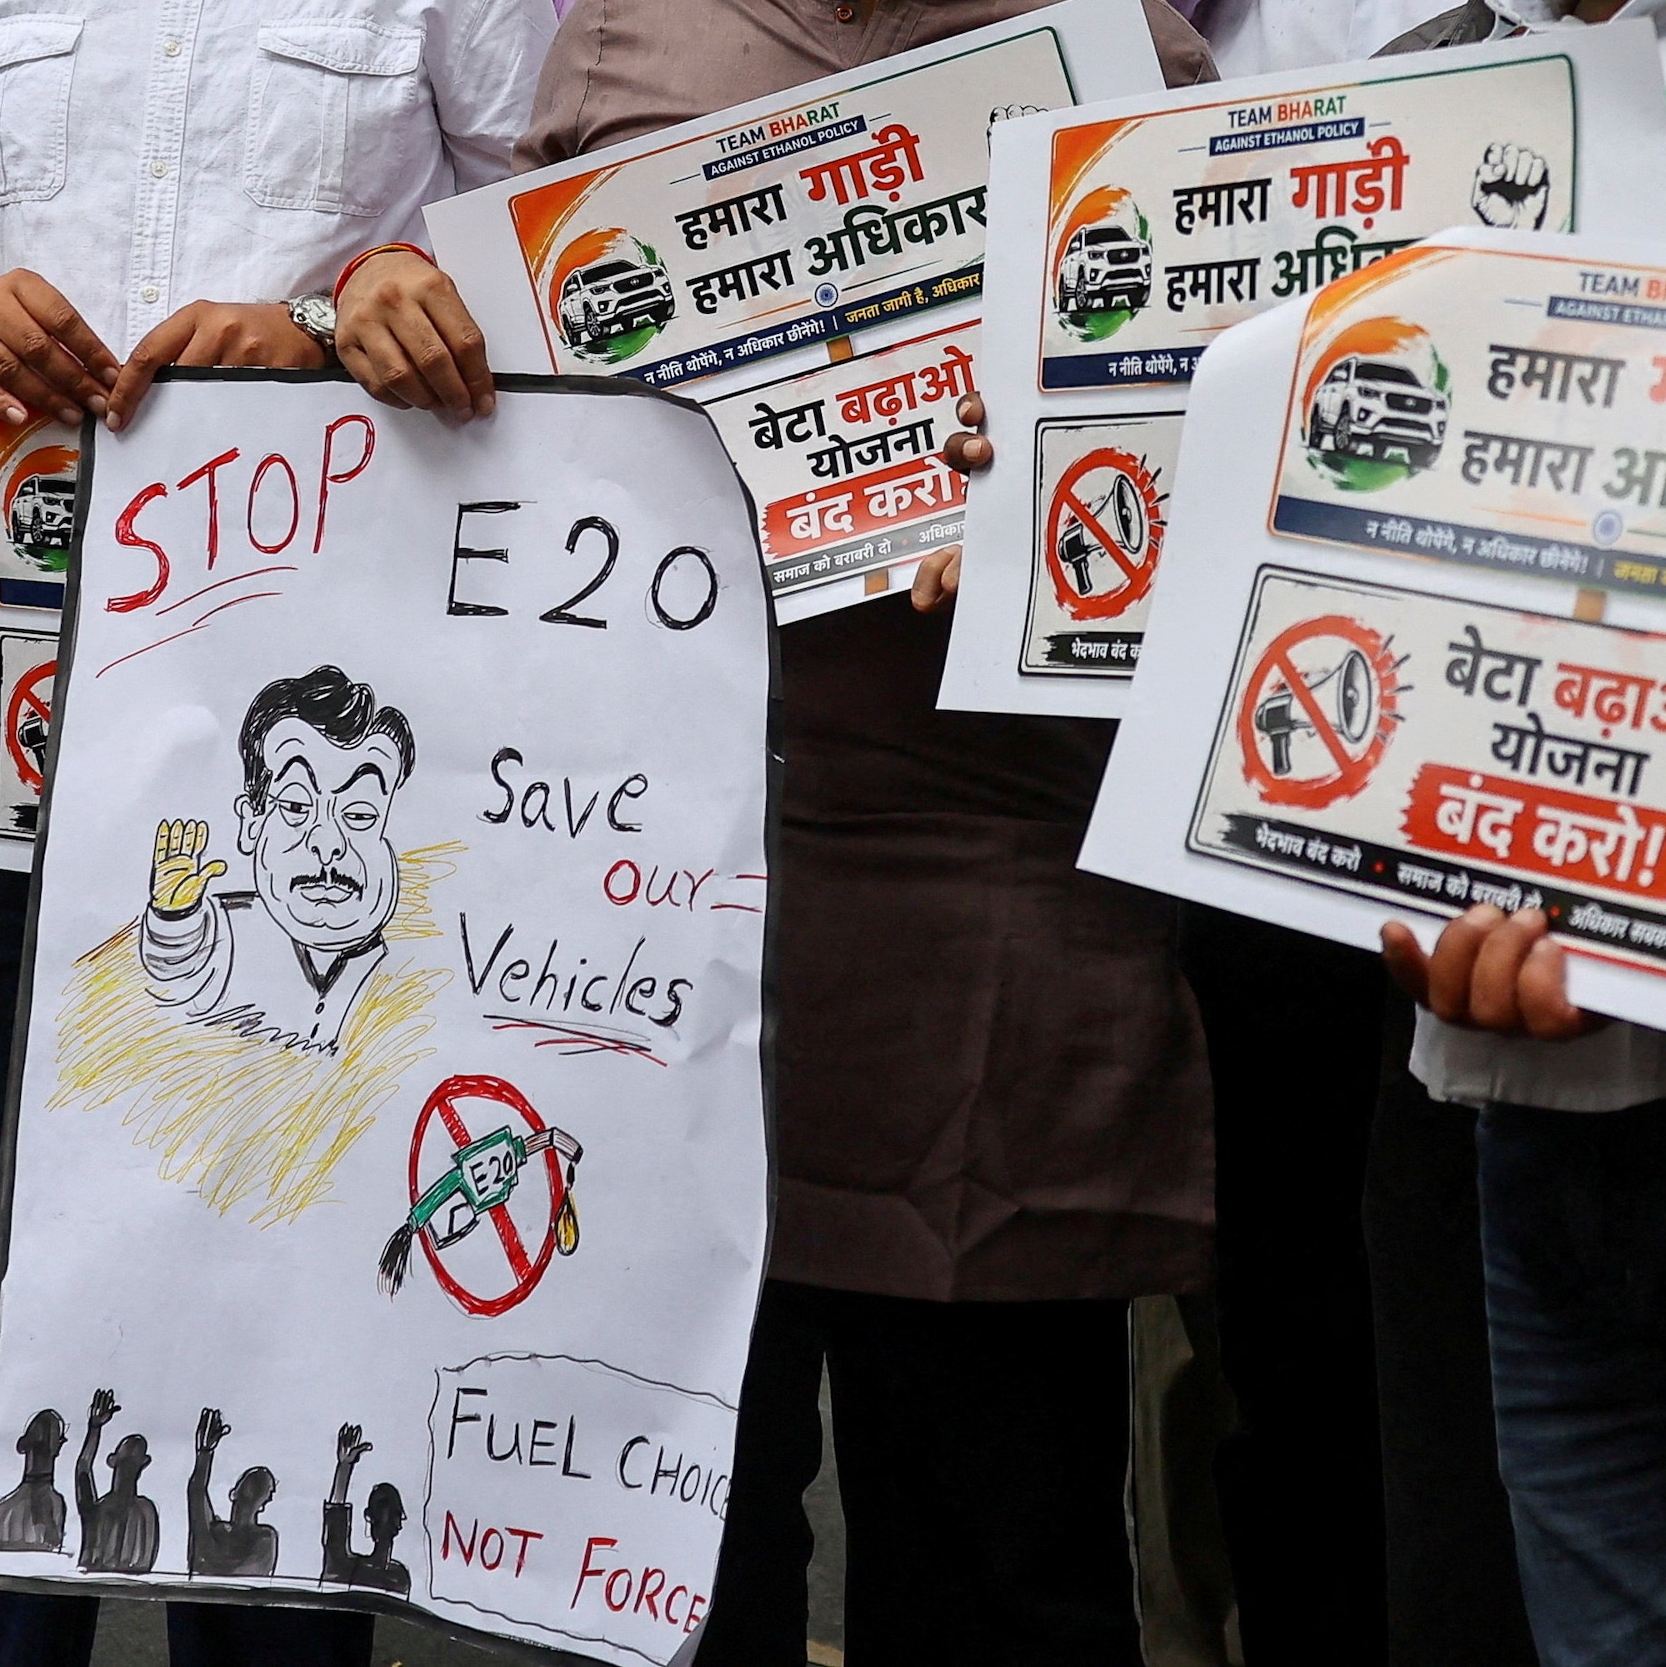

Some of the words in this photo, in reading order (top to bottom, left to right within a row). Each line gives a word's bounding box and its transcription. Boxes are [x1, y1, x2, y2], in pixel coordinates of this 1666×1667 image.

[711, 151, 758, 175] AGAINST
[761, 135, 816, 158] ETHANOL
[817, 120, 857, 141] POLICY
[715, 125, 766, 153] TEAM
[768, 101, 839, 137] BHARAT
[1215, 134, 1261, 151] AGAINST
[1264, 127, 1314, 145] ETHANOL
[1317, 121, 1358, 137] POLICY
[1227, 105, 1271, 128] TEAM
[1277, 94, 1346, 122] BHARAT
[674, 183, 786, 250] हमारा
[800, 124, 923, 203] गाड़ी
[1172, 177, 1272, 235] हमारा
[1290, 136, 1409, 228] गाड़ी
[685, 248, 794, 314] हमारा
[803, 184, 991, 275] अधिकार
[1164, 256, 1260, 312] हमारा
[1578, 271, 1640, 297] TEAM
[844, 303, 879, 322] जनता
[881, 290, 912, 311] जागी
[931, 272, 980, 297] अधिकार
[644, 371, 654, 383] न
[655, 360, 683, 380] नीति
[723, 347, 734, 359] न
[737, 332, 784, 356] अधिकार
[1486, 343, 1626, 408] हमारा
[747, 399, 825, 449] बेटा
[836, 346, 973, 422] बढ़ाओ
[805, 417, 934, 478] योजना
[1460, 429, 1595, 494] हमारा
[104, 414, 375, 614] STOP
[786, 492, 853, 538] बंद
[446, 500, 719, 631] E20
[1444, 623, 1543, 707] बेटा
[1491, 710, 1651, 797] योजना
[477, 746, 648, 839] Save
[1437, 774, 1523, 856] बंद
[1532, 805, 1664, 885] करो!
[458, 911, 694, 1029] Vehicles
[469, 1150, 514, 1197] E20
[447, 1387, 592, 1480] FUEL
[441, 1510, 544, 1578] NOT
[570, 1537, 706, 1634] FORCE
